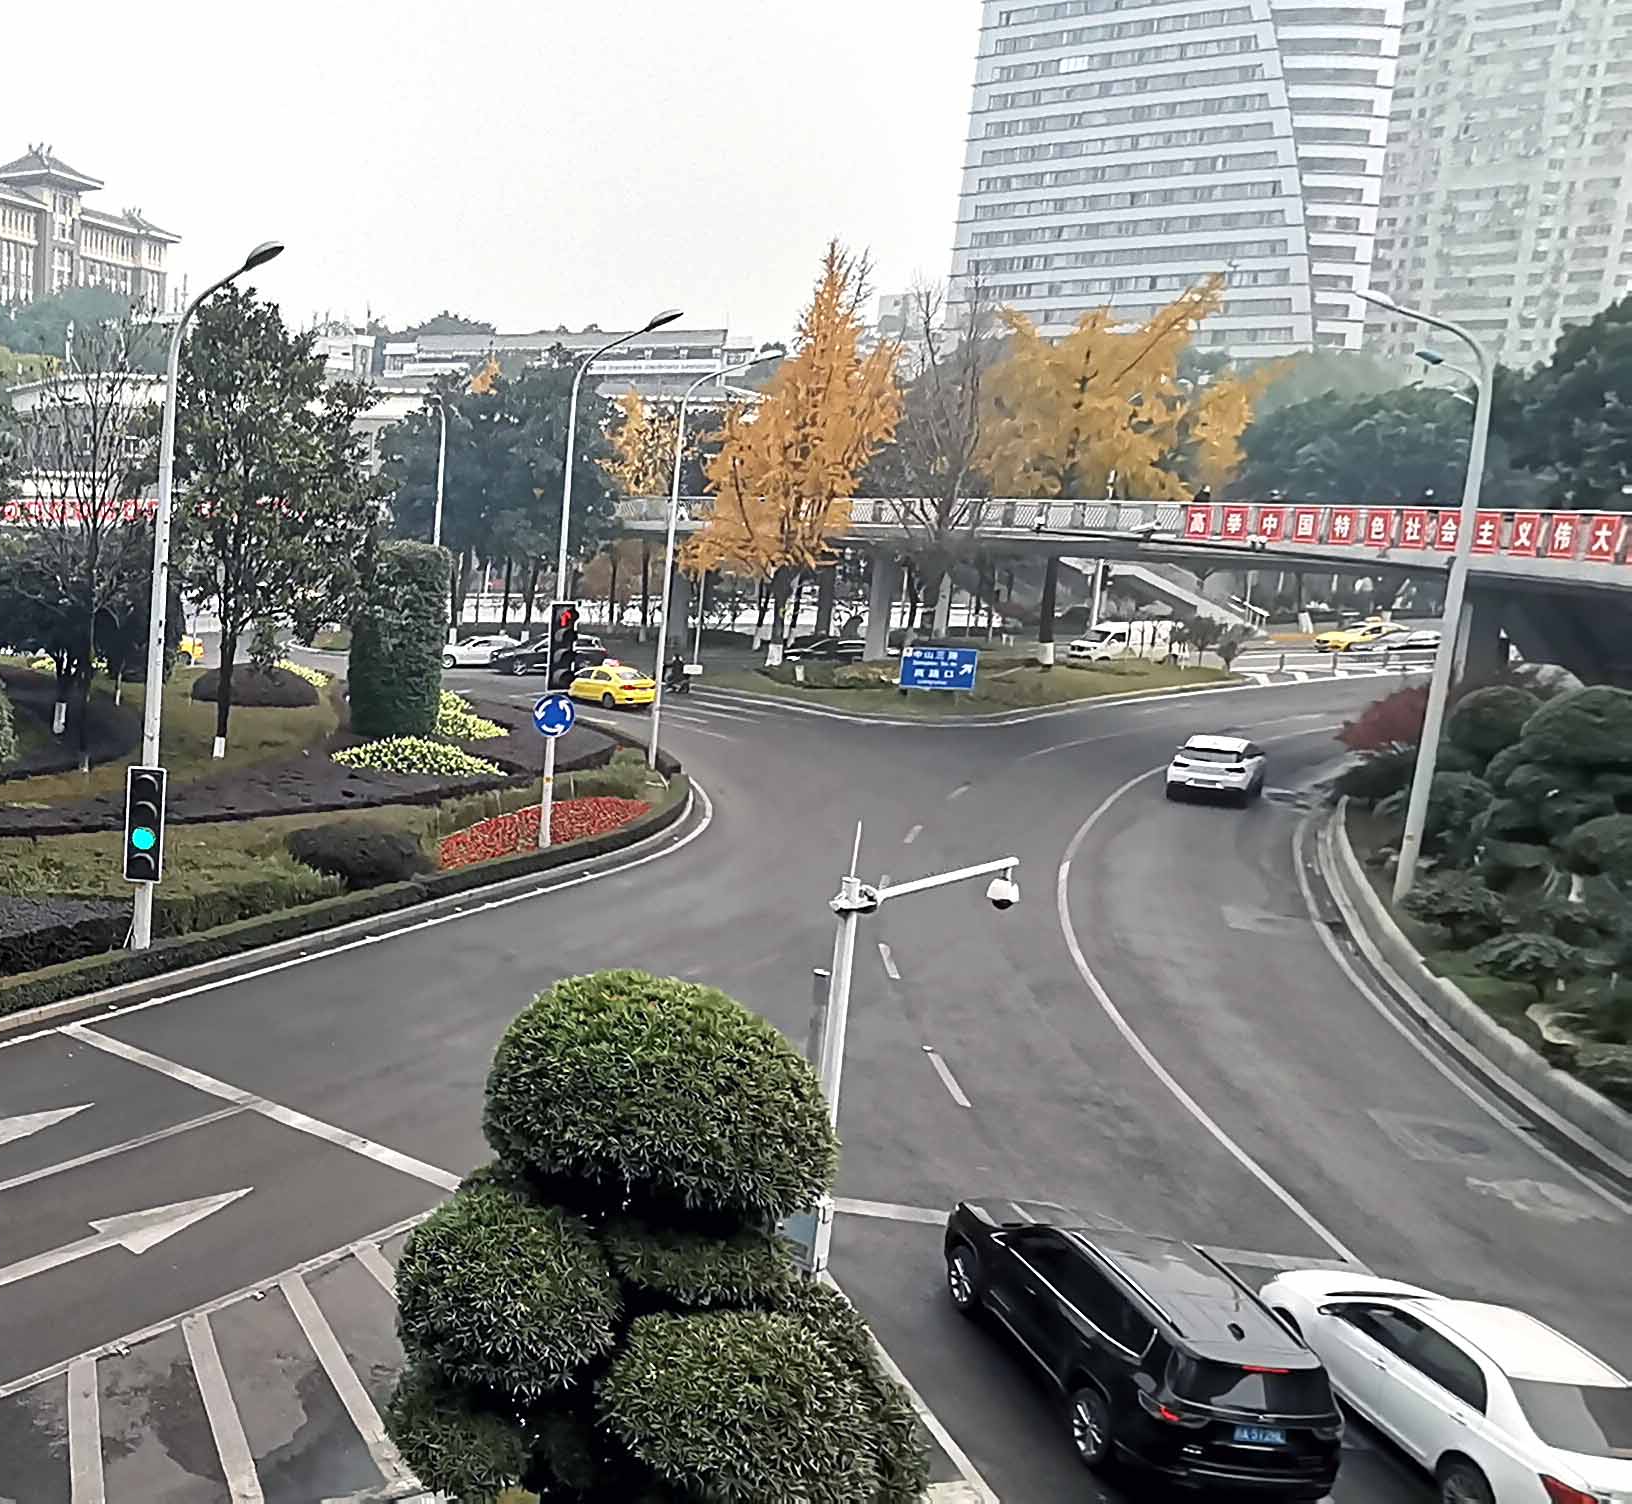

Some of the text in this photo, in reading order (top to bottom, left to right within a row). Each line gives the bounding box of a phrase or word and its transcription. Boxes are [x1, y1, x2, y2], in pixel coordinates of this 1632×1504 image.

[1189, 511, 1613, 552] 高举中国特色社会主义伟大
